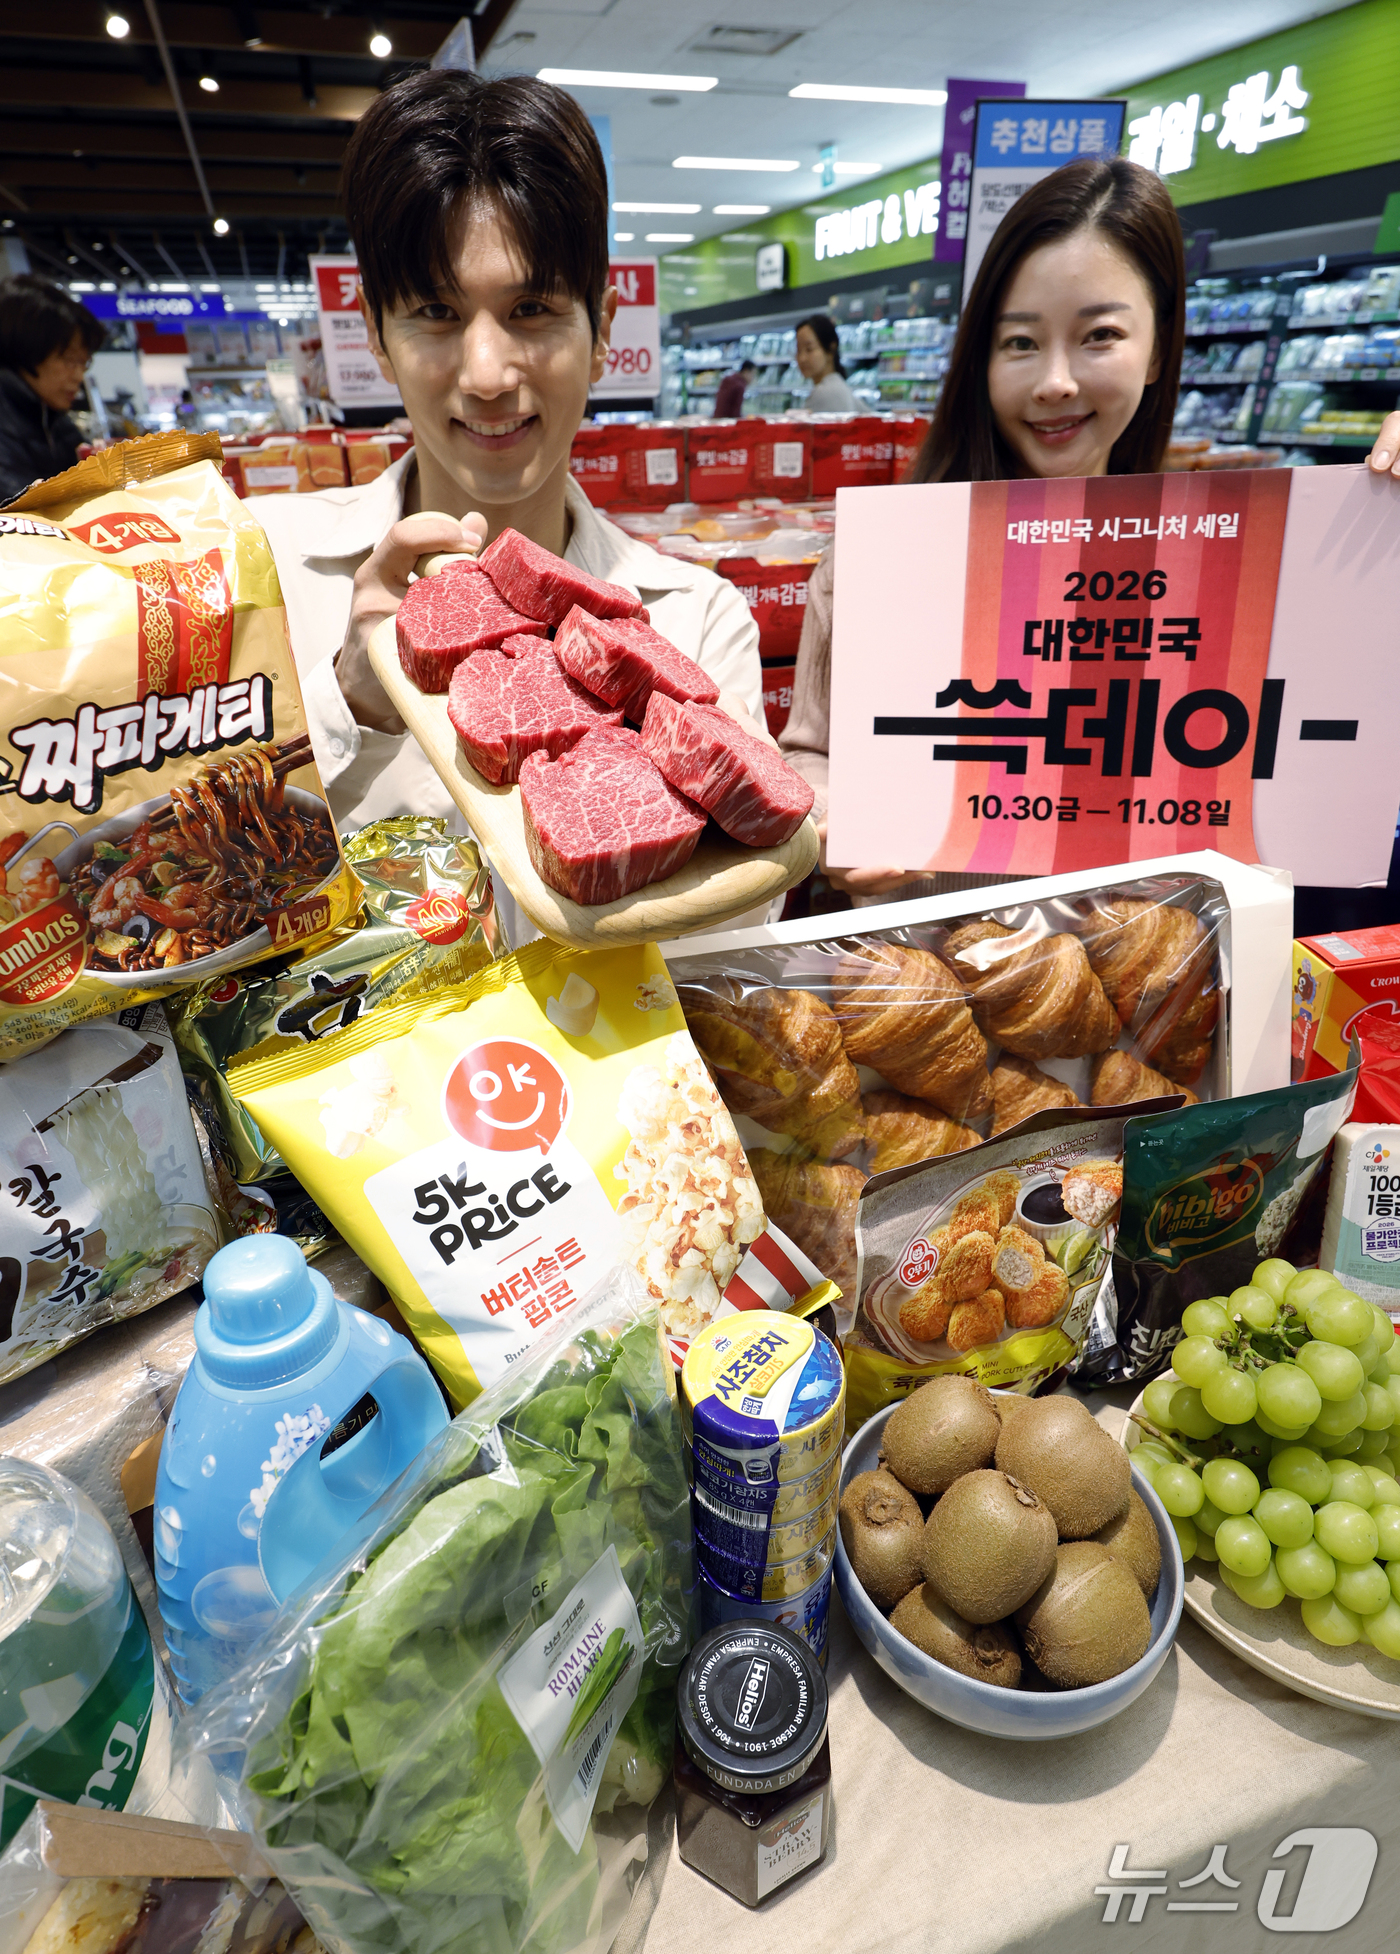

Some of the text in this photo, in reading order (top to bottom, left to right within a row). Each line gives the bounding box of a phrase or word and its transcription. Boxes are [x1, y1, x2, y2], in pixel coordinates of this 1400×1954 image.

[990, 117, 1106, 154] 추천상품
[815, 199, 883, 261] FRUIT
[881, 193, 902, 244] &
[116, 298, 194, 316] SEAFOOD
[88, 523, 173, 550] 4개입
[1007, 512, 1239, 544] 대한민국 시그니처 세일
[738, 581, 809, 608] 빛가득감귤
[1063, 569, 1167, 602] 2026
[1022, 616, 1202, 662] 대한민국
[10, 673, 270, 811] 짜파게티
[275, 905, 329, 947] 4개입
[1363, 1164, 1389, 1173] 제일제당
[1366, 1151, 1375, 1159] CJ
[412, 1161, 488, 1226] 5K
[1158, 1184, 1255, 1230] bibigo
[8, 1164, 99, 1306] 칼국수
[1166, 1216, 1210, 1234] 비비고
[1365, 1229, 1400, 1242] 물가안
[1365, 1239, 1400, 1251] 프로젝
[480, 1237, 587, 1317] 버터솔트
[907, 1259, 931, 1281] 오뚜기
[520, 1279, 577, 1330] 팝콘
[1070, 1300, 1089, 1321] 국산
[718, 1340, 732, 1353] SAJO
[715, 1330, 790, 1401] 사조참치
[749, 1357, 785, 1391] 살코기S
[981, 1360, 999, 1371] MINI
[981, 1368, 1002, 1381] PORK
[543, 1630, 562, 1658] 신선
[547, 1617, 607, 1698] ROMAINE
[566, 1641, 604, 1700] HEART
[698, 1638, 760, 1746] EMPRESA FAMILIAR DESDE 1901
[738, 1662, 767, 1728] Helios
[744, 1643, 808, 1752] EMPRESA FAMILIAR DESDE 1901
[706, 1764, 773, 1790] FUNDADA
[778, 1770, 796, 1785] EN
[775, 1810, 810, 1839] Helios
[769, 1836, 811, 1869] BERRY
